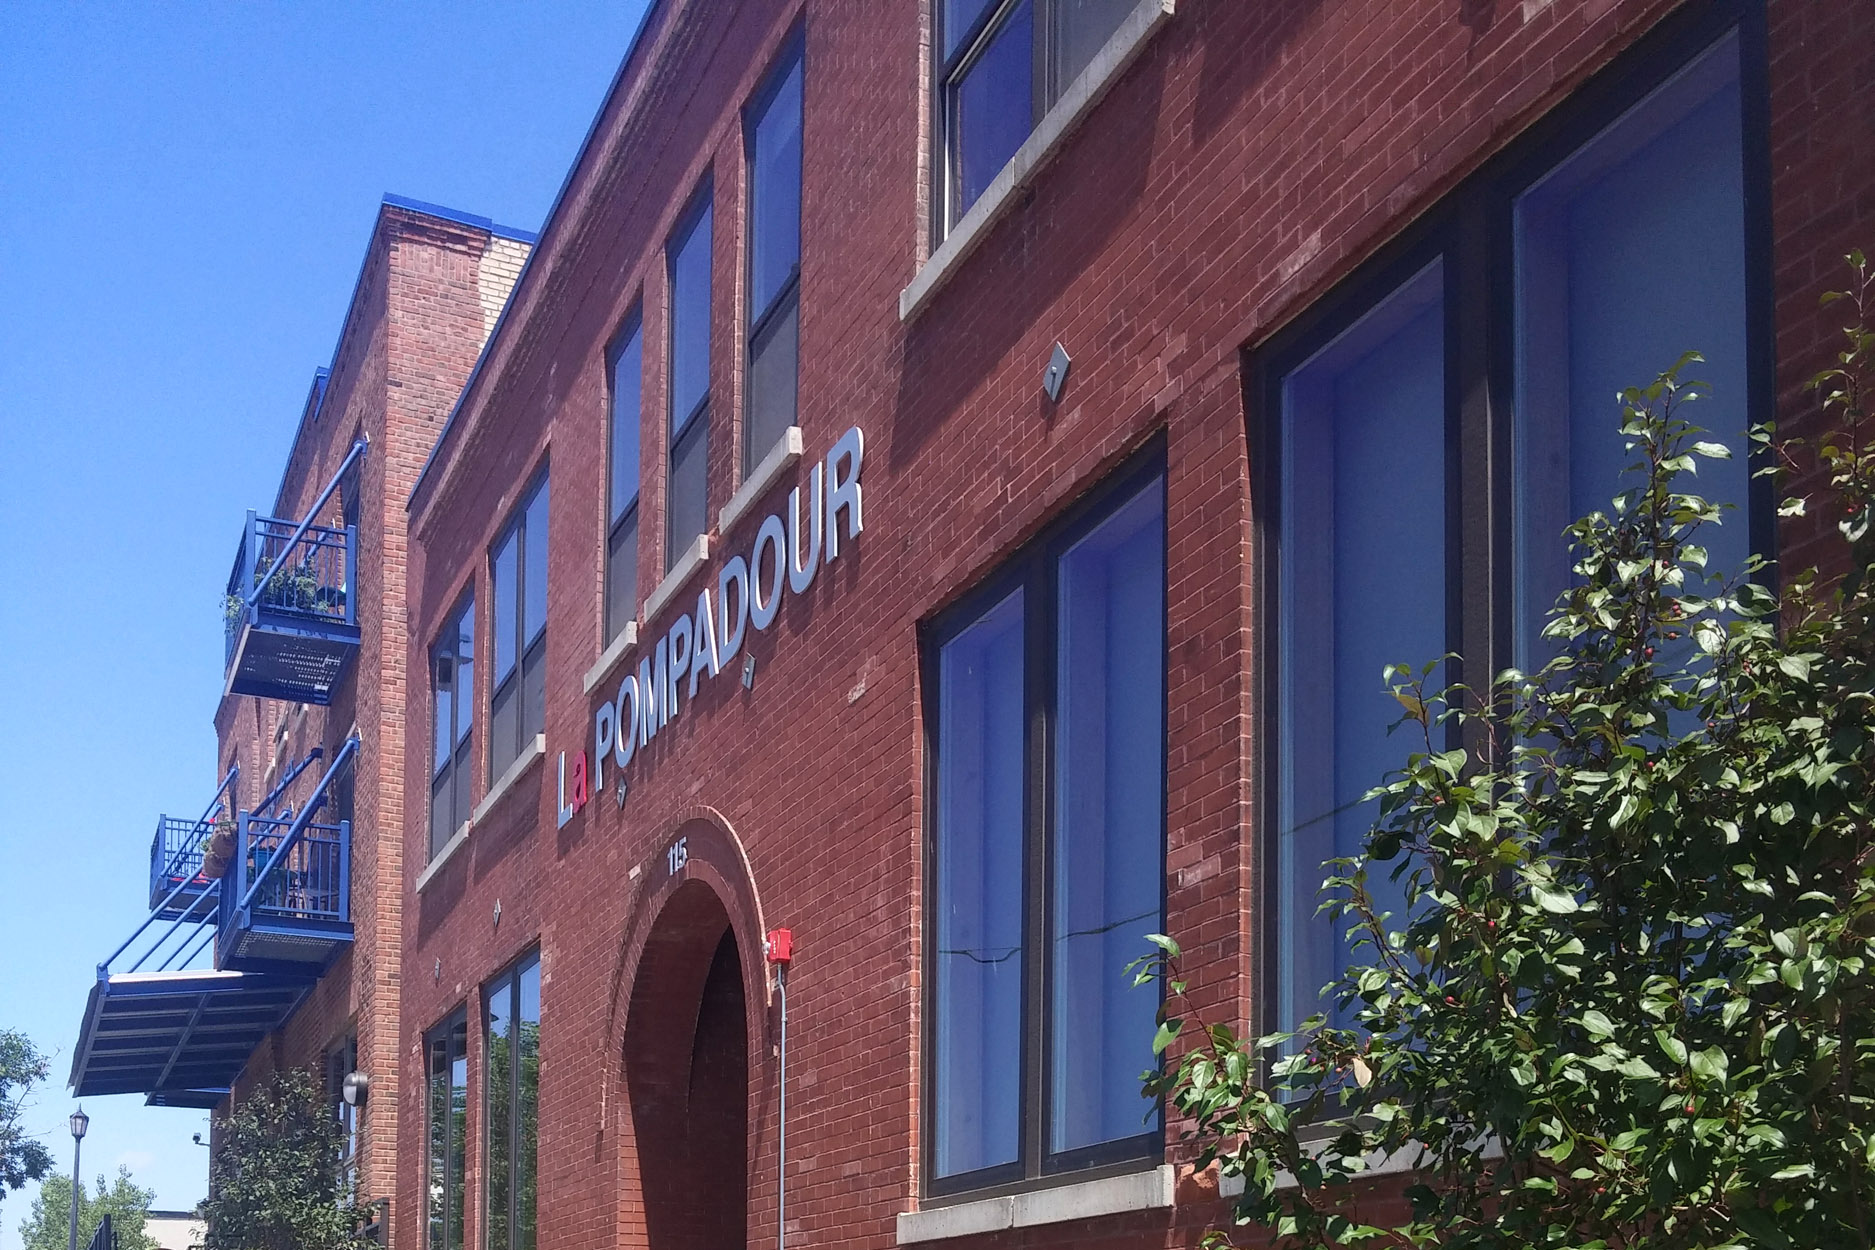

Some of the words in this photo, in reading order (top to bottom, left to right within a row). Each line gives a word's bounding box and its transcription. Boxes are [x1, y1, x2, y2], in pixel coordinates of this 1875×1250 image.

[558, 751, 587, 830] La
[595, 426, 864, 793] POMPADOUR
[667, 836, 687, 876] 115
